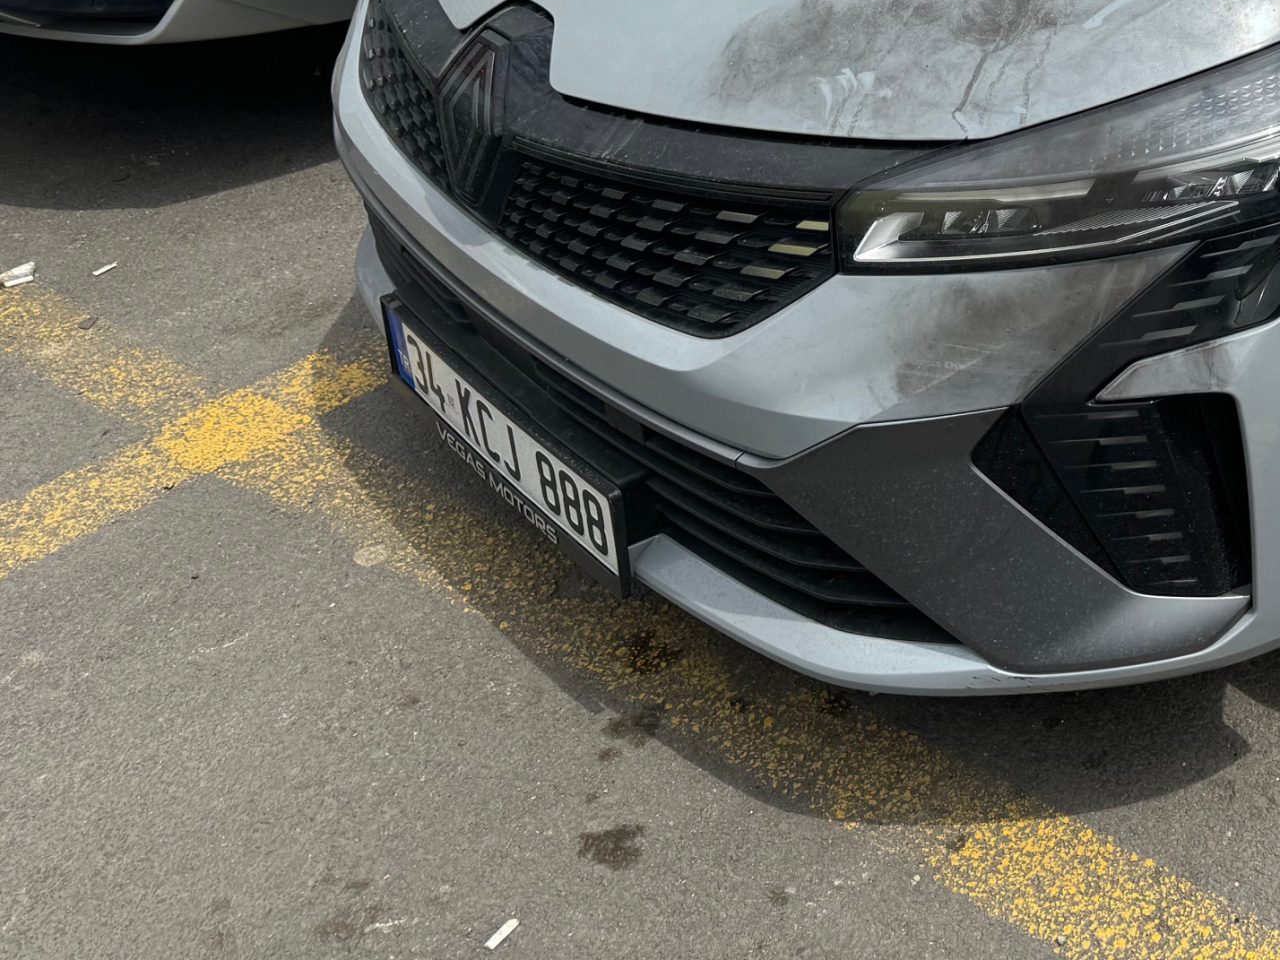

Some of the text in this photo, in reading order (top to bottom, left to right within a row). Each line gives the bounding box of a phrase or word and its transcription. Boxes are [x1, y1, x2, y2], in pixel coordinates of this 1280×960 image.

[407, 334, 608, 556] 34 KCJ 888
[436, 420, 558, 545] VEGAS MOTORS
